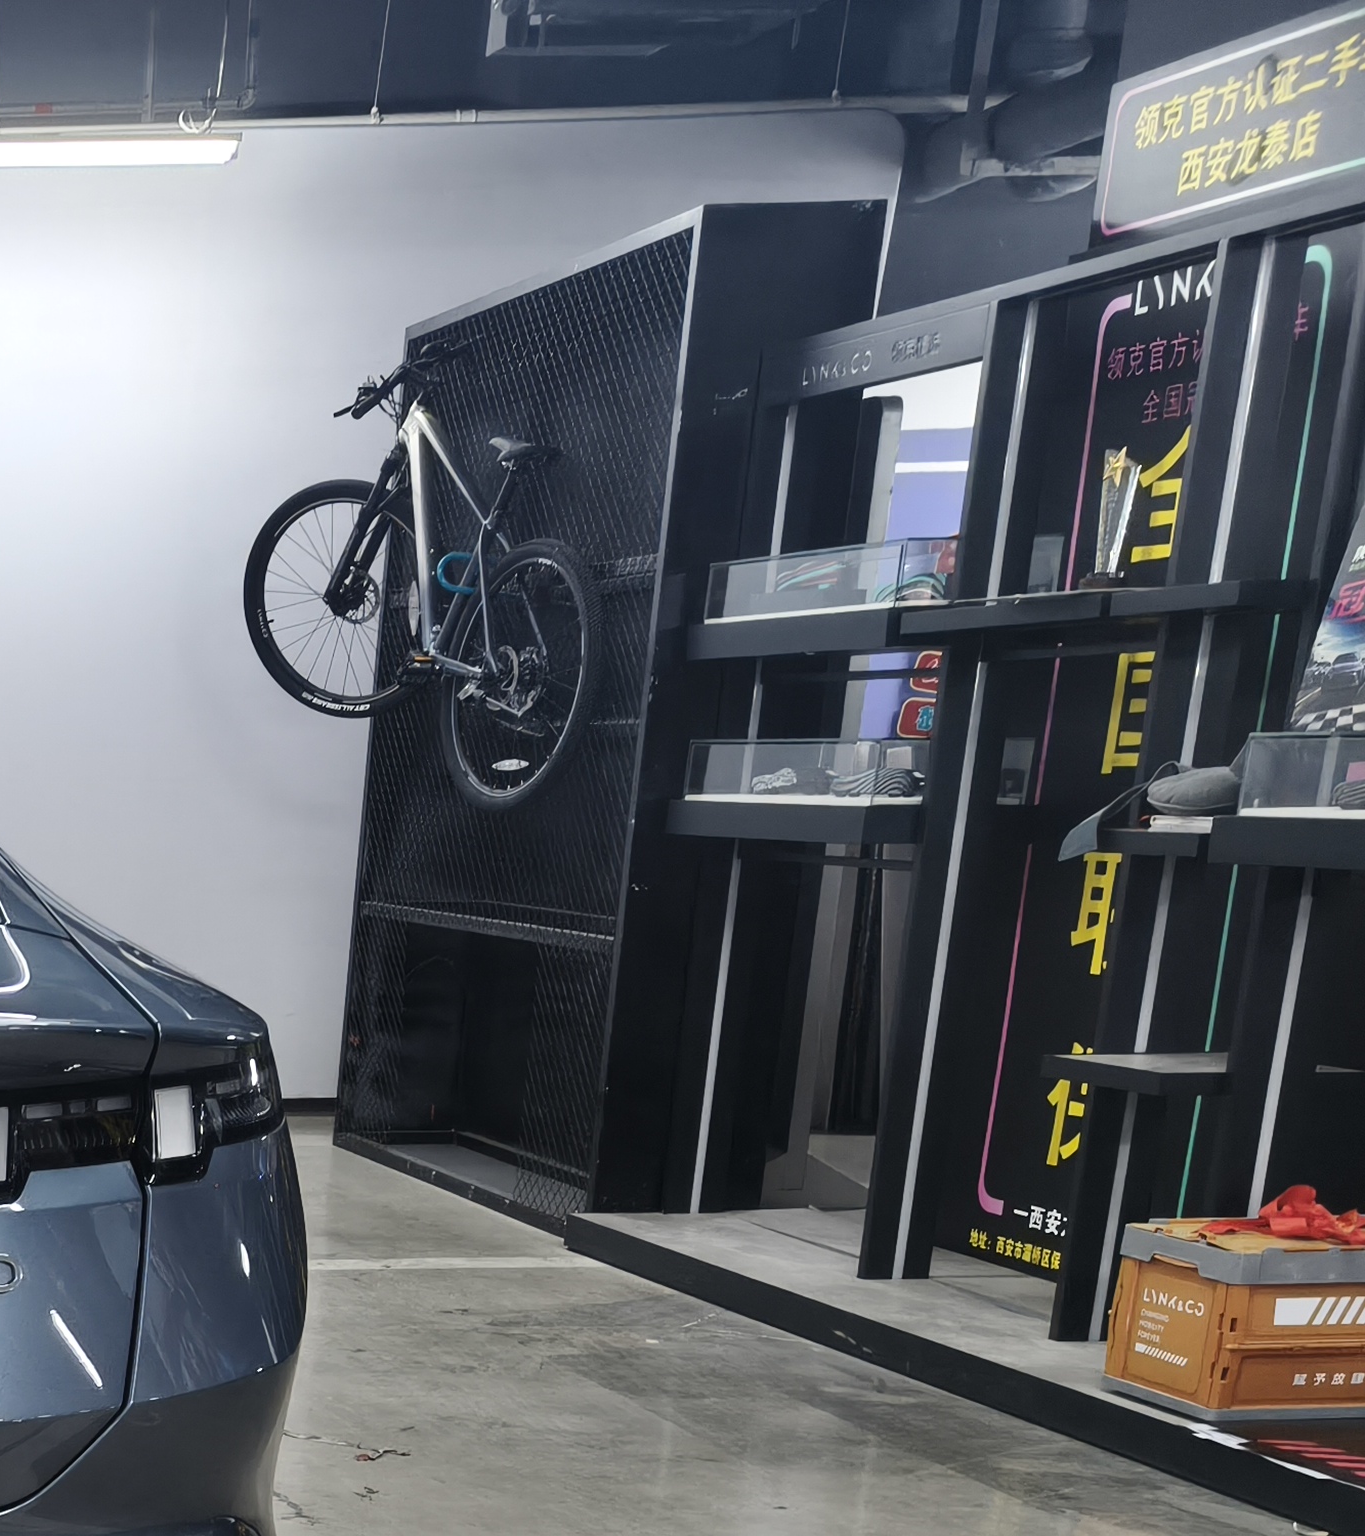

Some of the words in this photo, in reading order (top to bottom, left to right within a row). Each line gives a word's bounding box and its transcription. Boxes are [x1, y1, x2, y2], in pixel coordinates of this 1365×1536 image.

[1134, 33, 1365, 149] 领克官方认证二手
[1176, 110, 1323, 196] 西安龙泰店
[1143, 1287, 1205, 1317] LYNK&CO
